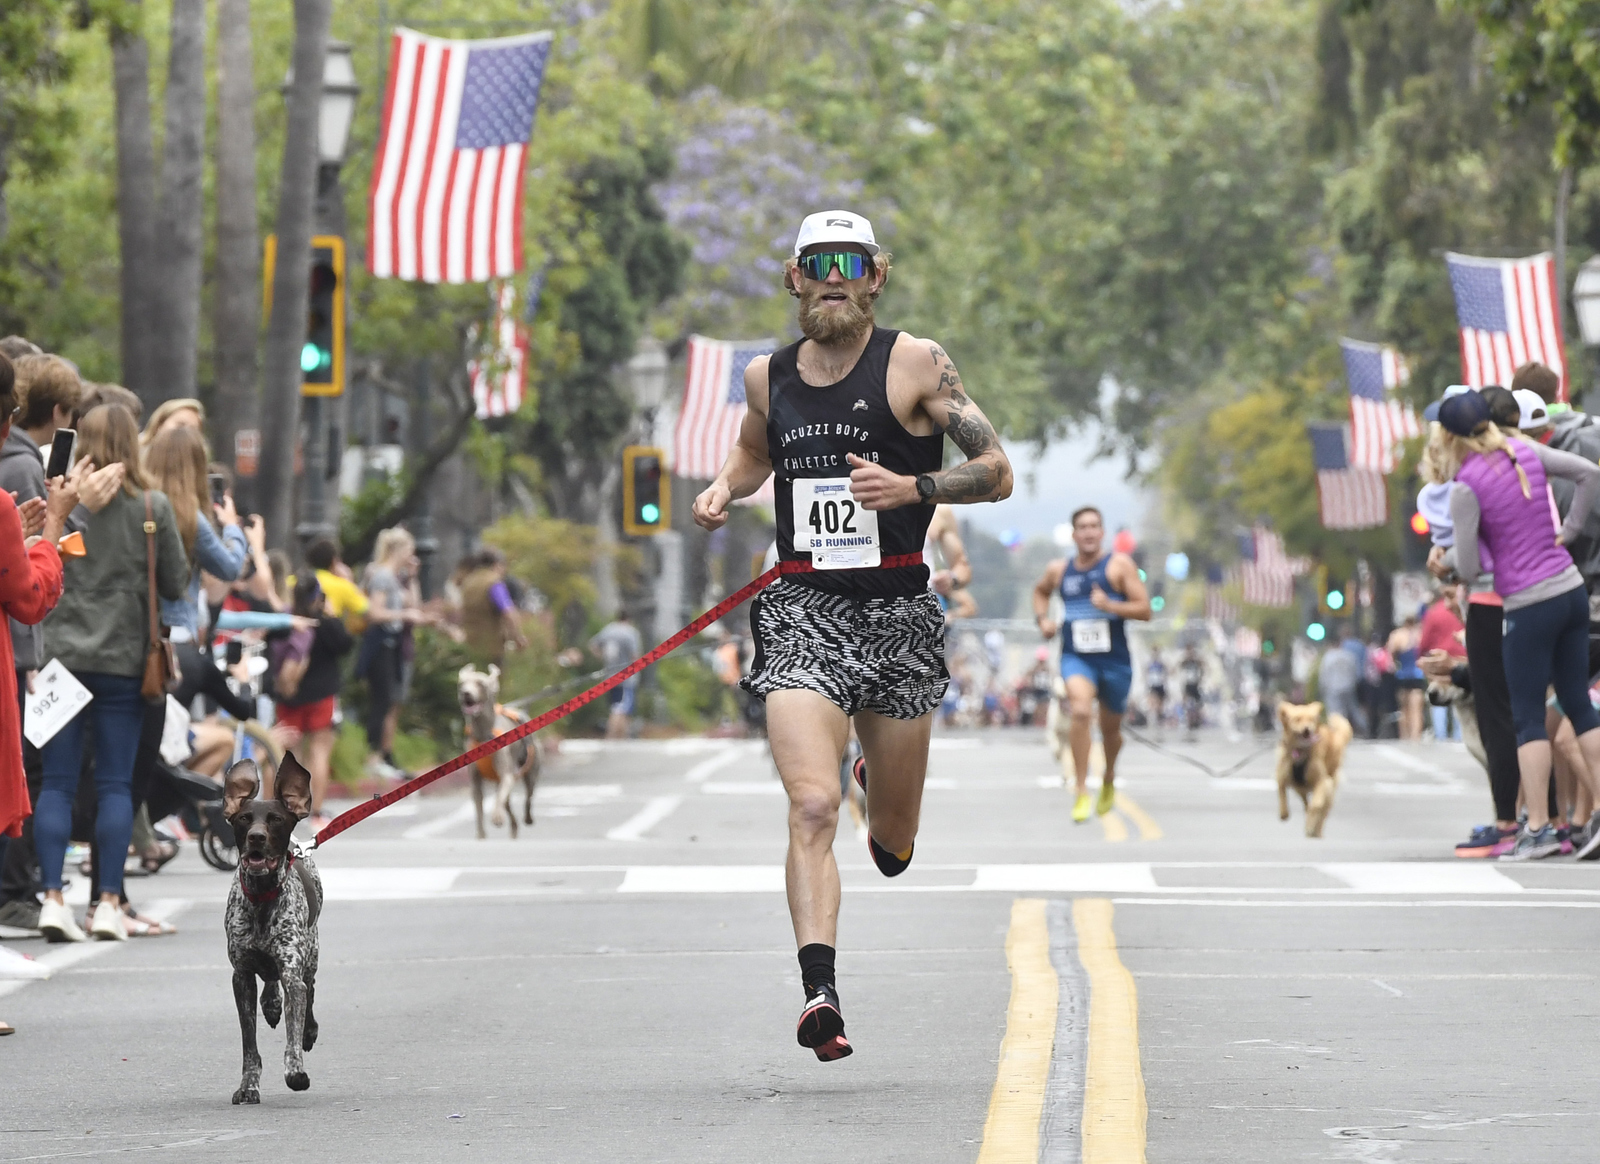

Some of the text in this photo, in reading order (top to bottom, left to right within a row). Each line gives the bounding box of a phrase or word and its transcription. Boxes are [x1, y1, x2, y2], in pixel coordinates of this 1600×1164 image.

[780, 423, 869, 448] JACUZZI BOYS
[845, 451, 880, 466] CUB
[808, 499, 857, 535] 402
[810, 535, 873, 548] SB RUNNING
[32, 691, 59, 717] 266
